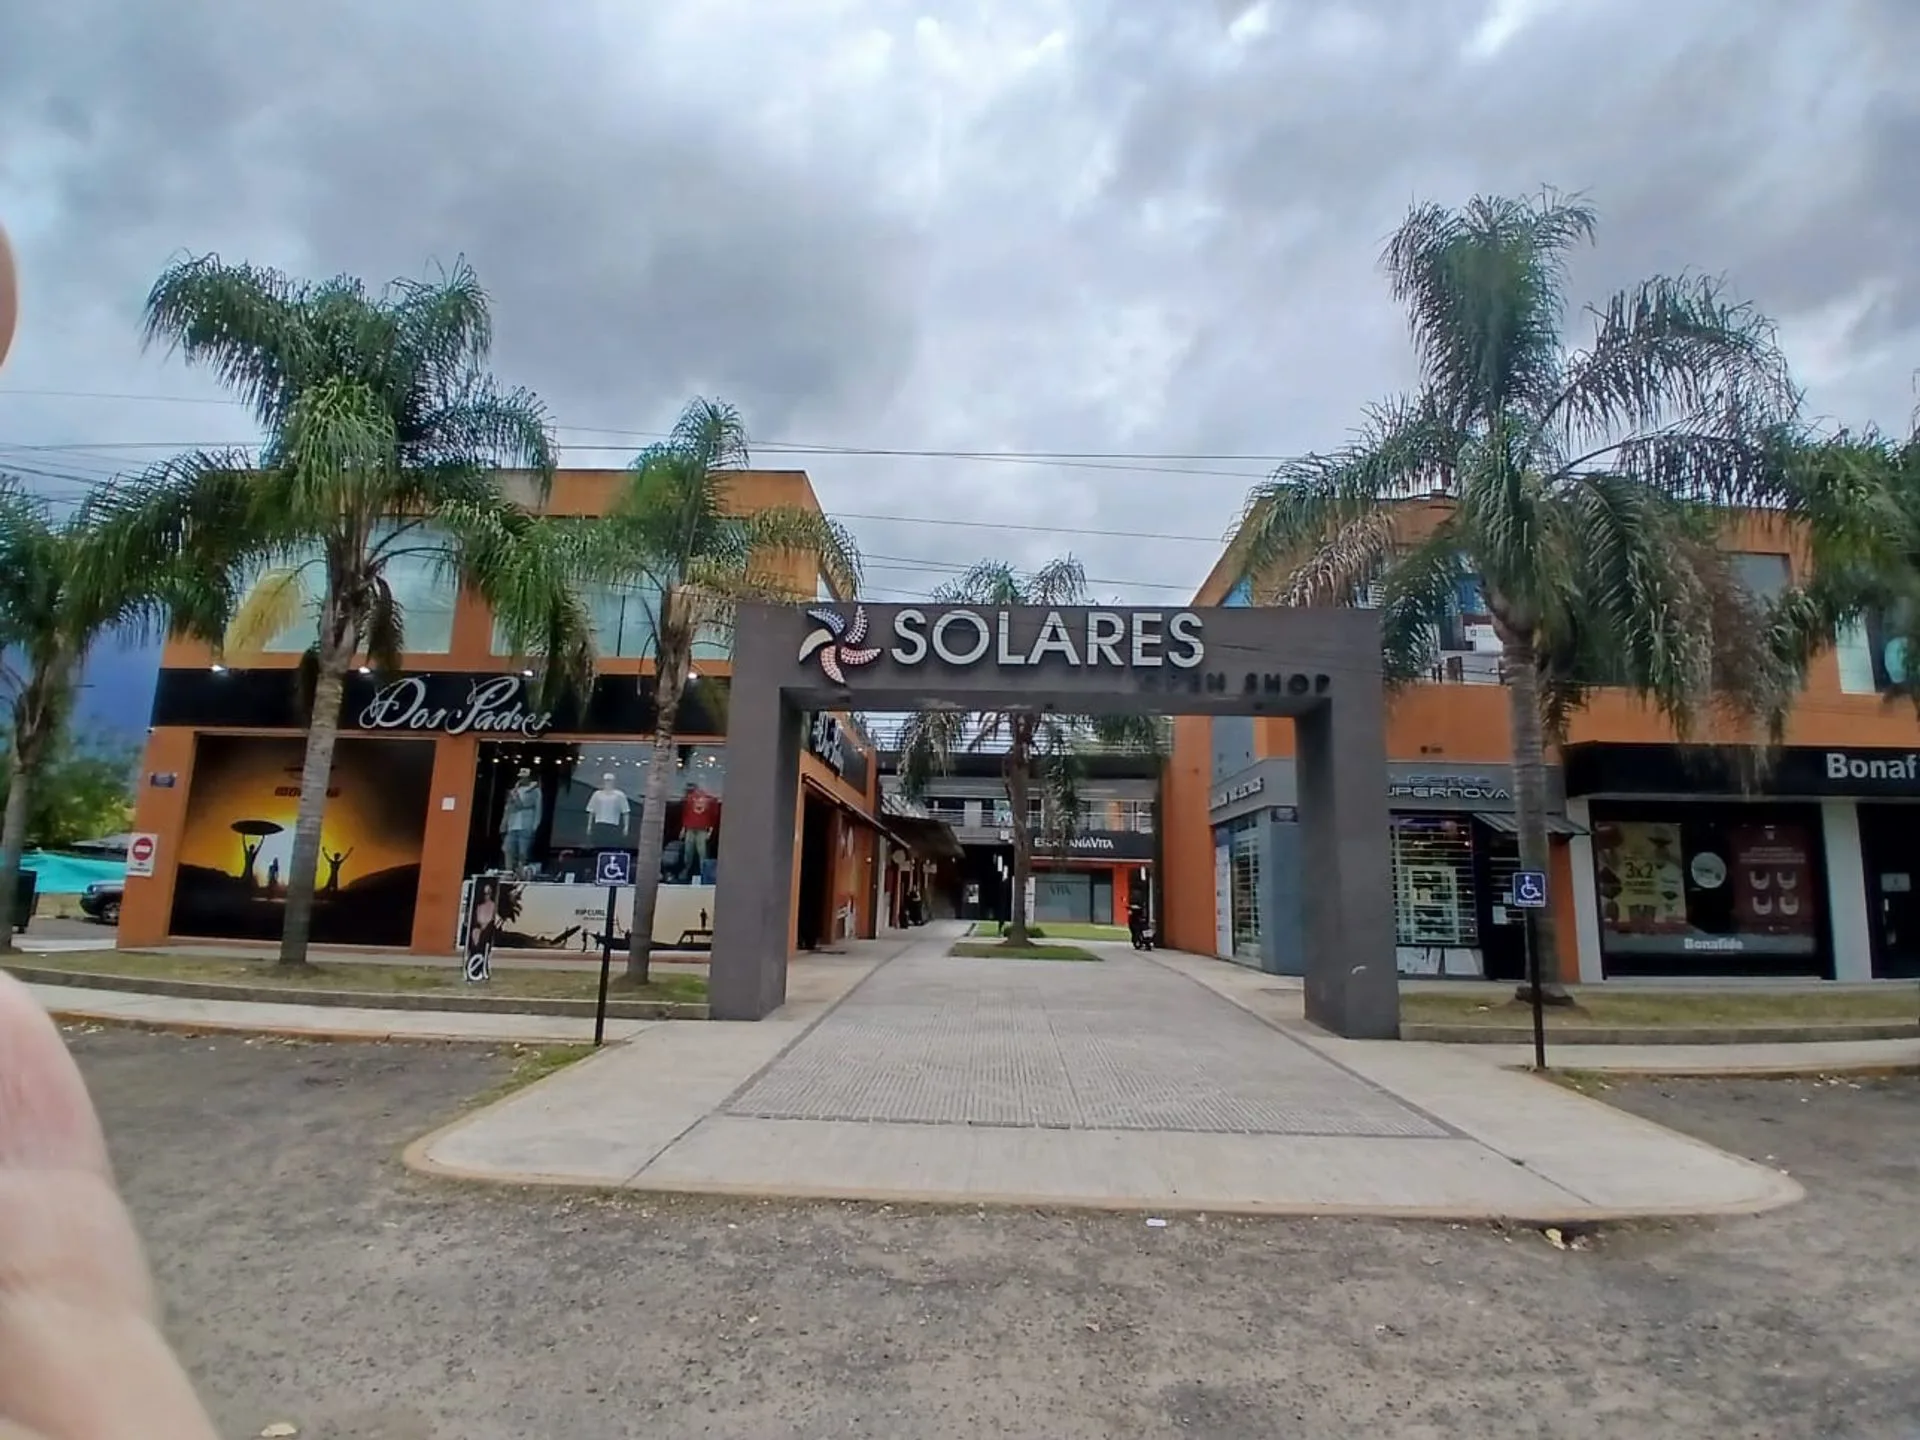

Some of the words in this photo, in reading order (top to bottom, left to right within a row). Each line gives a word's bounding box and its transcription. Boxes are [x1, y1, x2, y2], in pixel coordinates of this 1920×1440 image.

[891, 609, 1204, 668] SOLARES
[359, 676, 446, 728] Dos
[446, 676, 552, 737] Padres
[1244, 672, 1331, 695] SHOP
